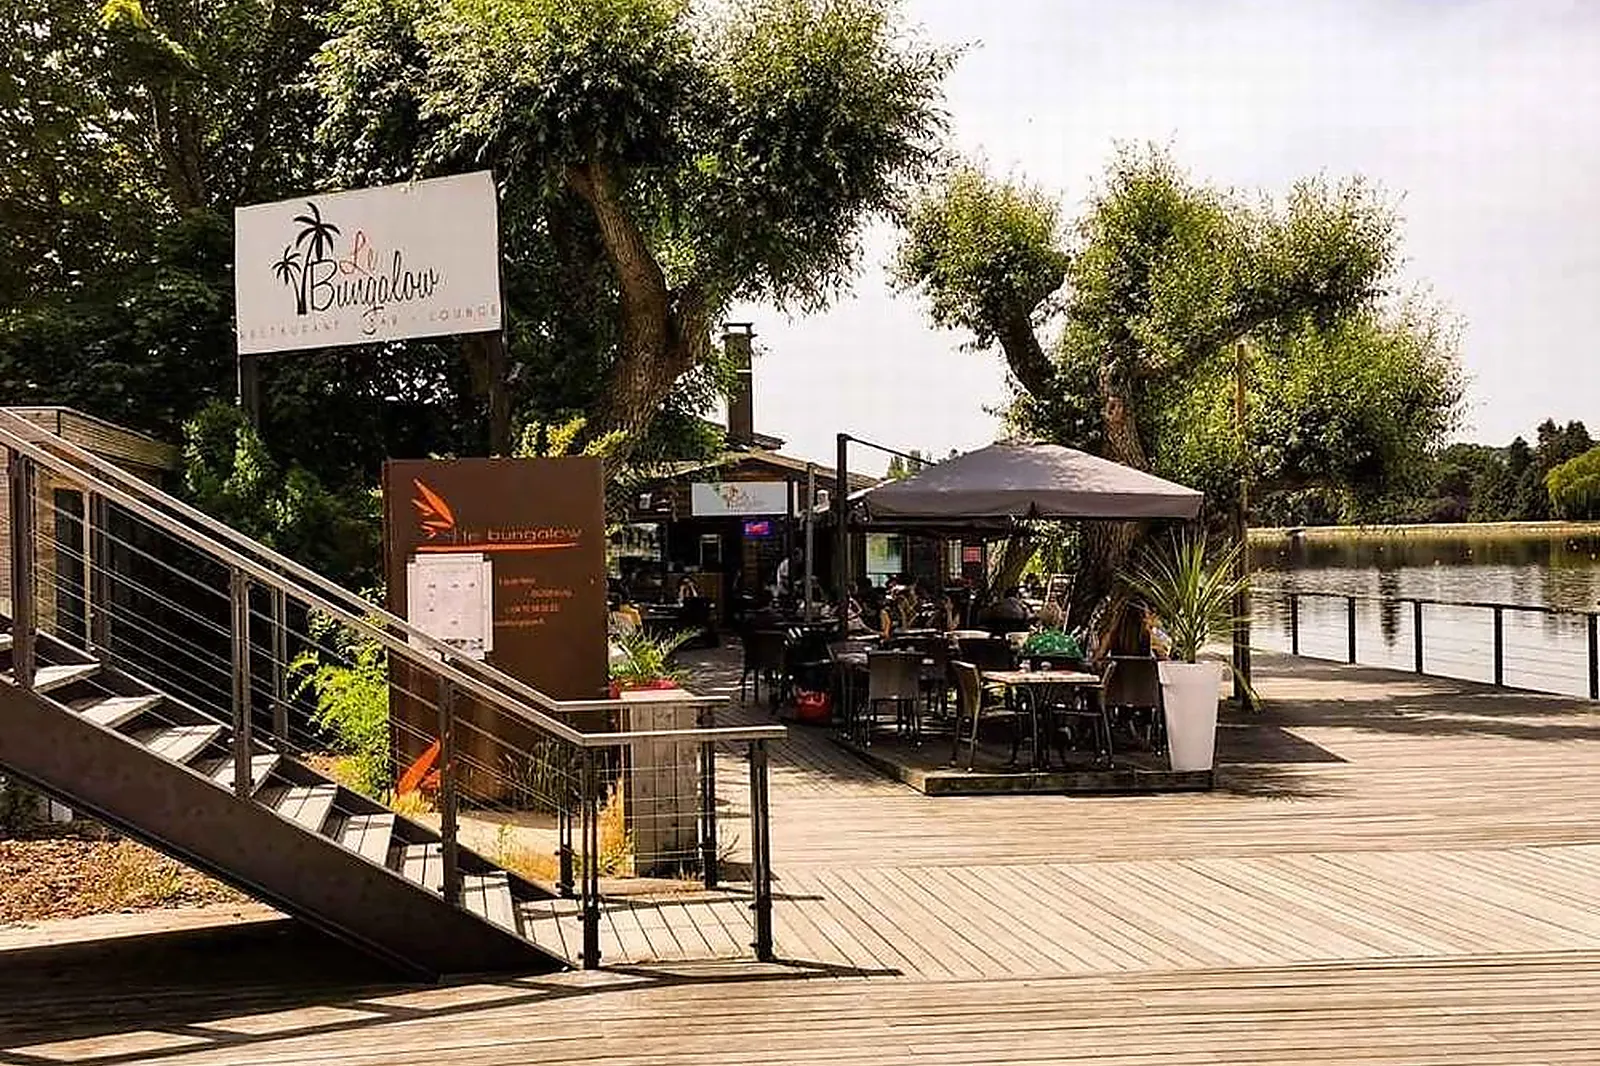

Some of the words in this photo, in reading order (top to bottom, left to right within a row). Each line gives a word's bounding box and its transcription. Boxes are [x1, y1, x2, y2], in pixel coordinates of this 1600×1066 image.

[338, 229, 377, 278] Le
[309, 249, 439, 335] Bungalow
[486, 524, 583, 543] bungalow
